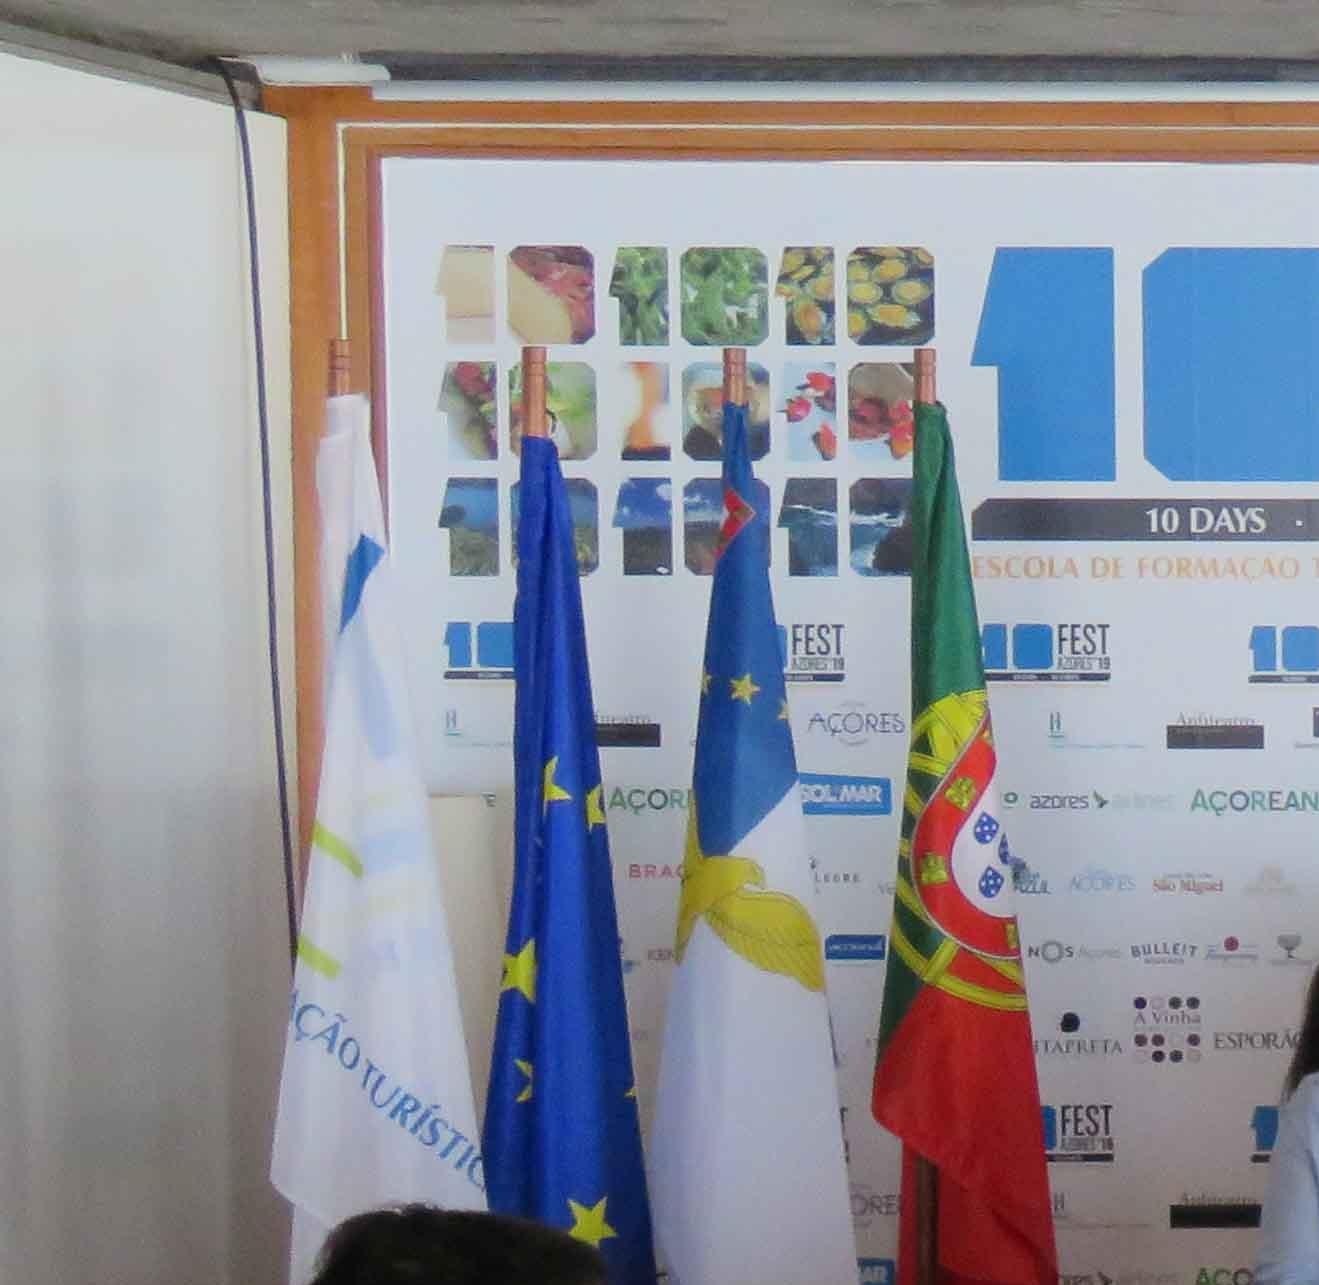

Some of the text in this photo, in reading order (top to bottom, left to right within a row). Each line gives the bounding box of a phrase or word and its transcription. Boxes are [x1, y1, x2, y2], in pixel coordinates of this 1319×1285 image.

[1145, 507, 1179, 534] 10
[1190, 507, 1266, 534] DAYS
[973, 556, 1079, 580] ESCOLA
[1091, 556, 1125, 580] DE
[1136, 552, 1300, 587] FORMAÇÃO
[792, 624, 844, 655] FEST
[1058, 624, 1110, 655] FEST
[808, 711, 905, 737] AÇORES
[1030, 793, 1090, 811] azores
[291, 990, 361, 1071] ÇÃO
[1152, 1011, 1201, 1025] Vinha
[1034, 1038, 1122, 1055] ITAPRETA
[1060, 1105, 1112, 1136] FEST
